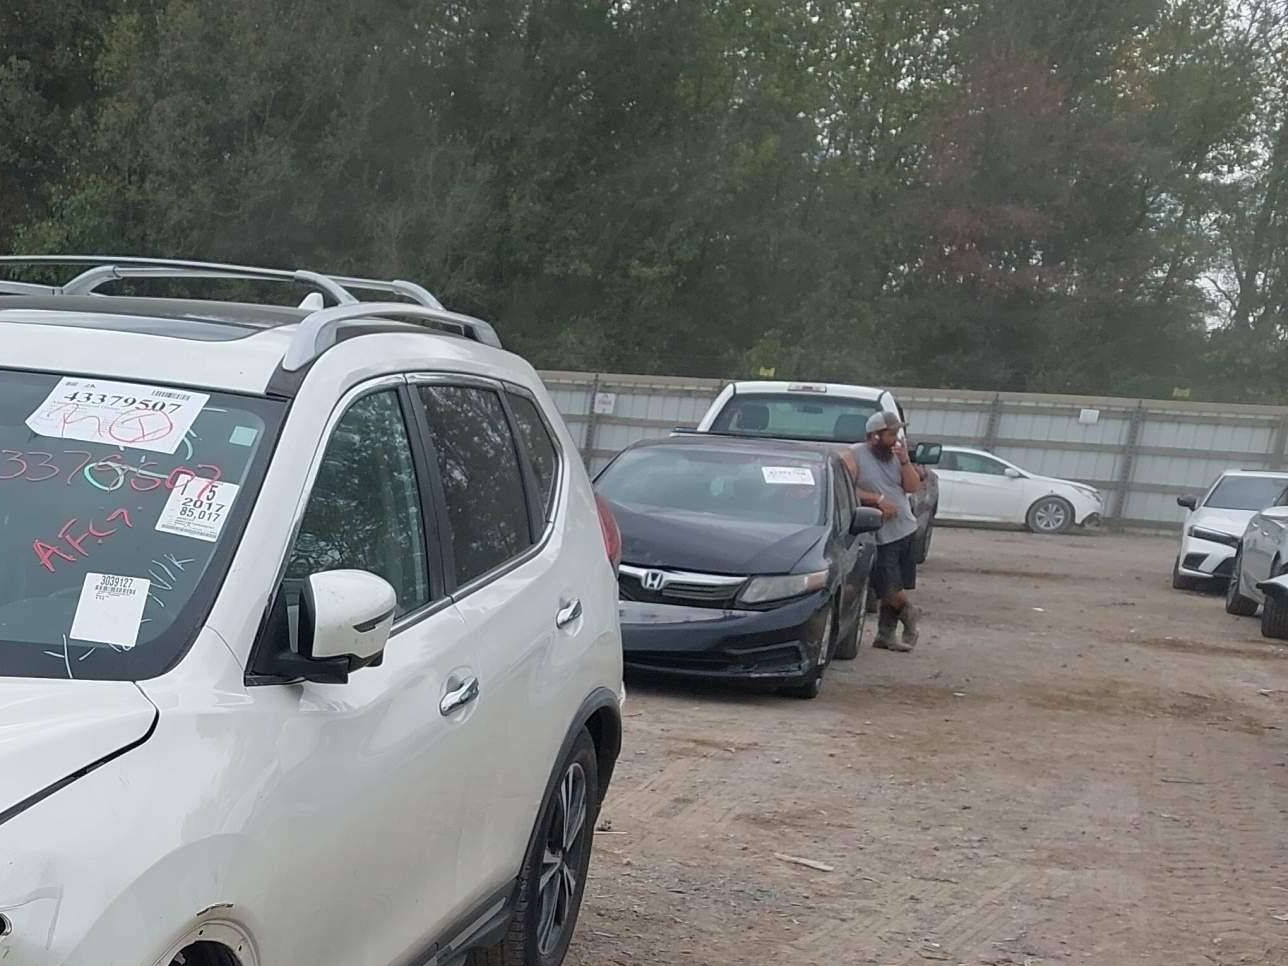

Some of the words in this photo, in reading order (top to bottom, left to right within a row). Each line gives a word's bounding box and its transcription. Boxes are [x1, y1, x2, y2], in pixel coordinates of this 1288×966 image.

[63, 391, 182, 415] 43379507
[181, 497, 226, 513] 2017
[179, 506, 221, 522] 85,017
[100, 575, 134, 589] 3039127
